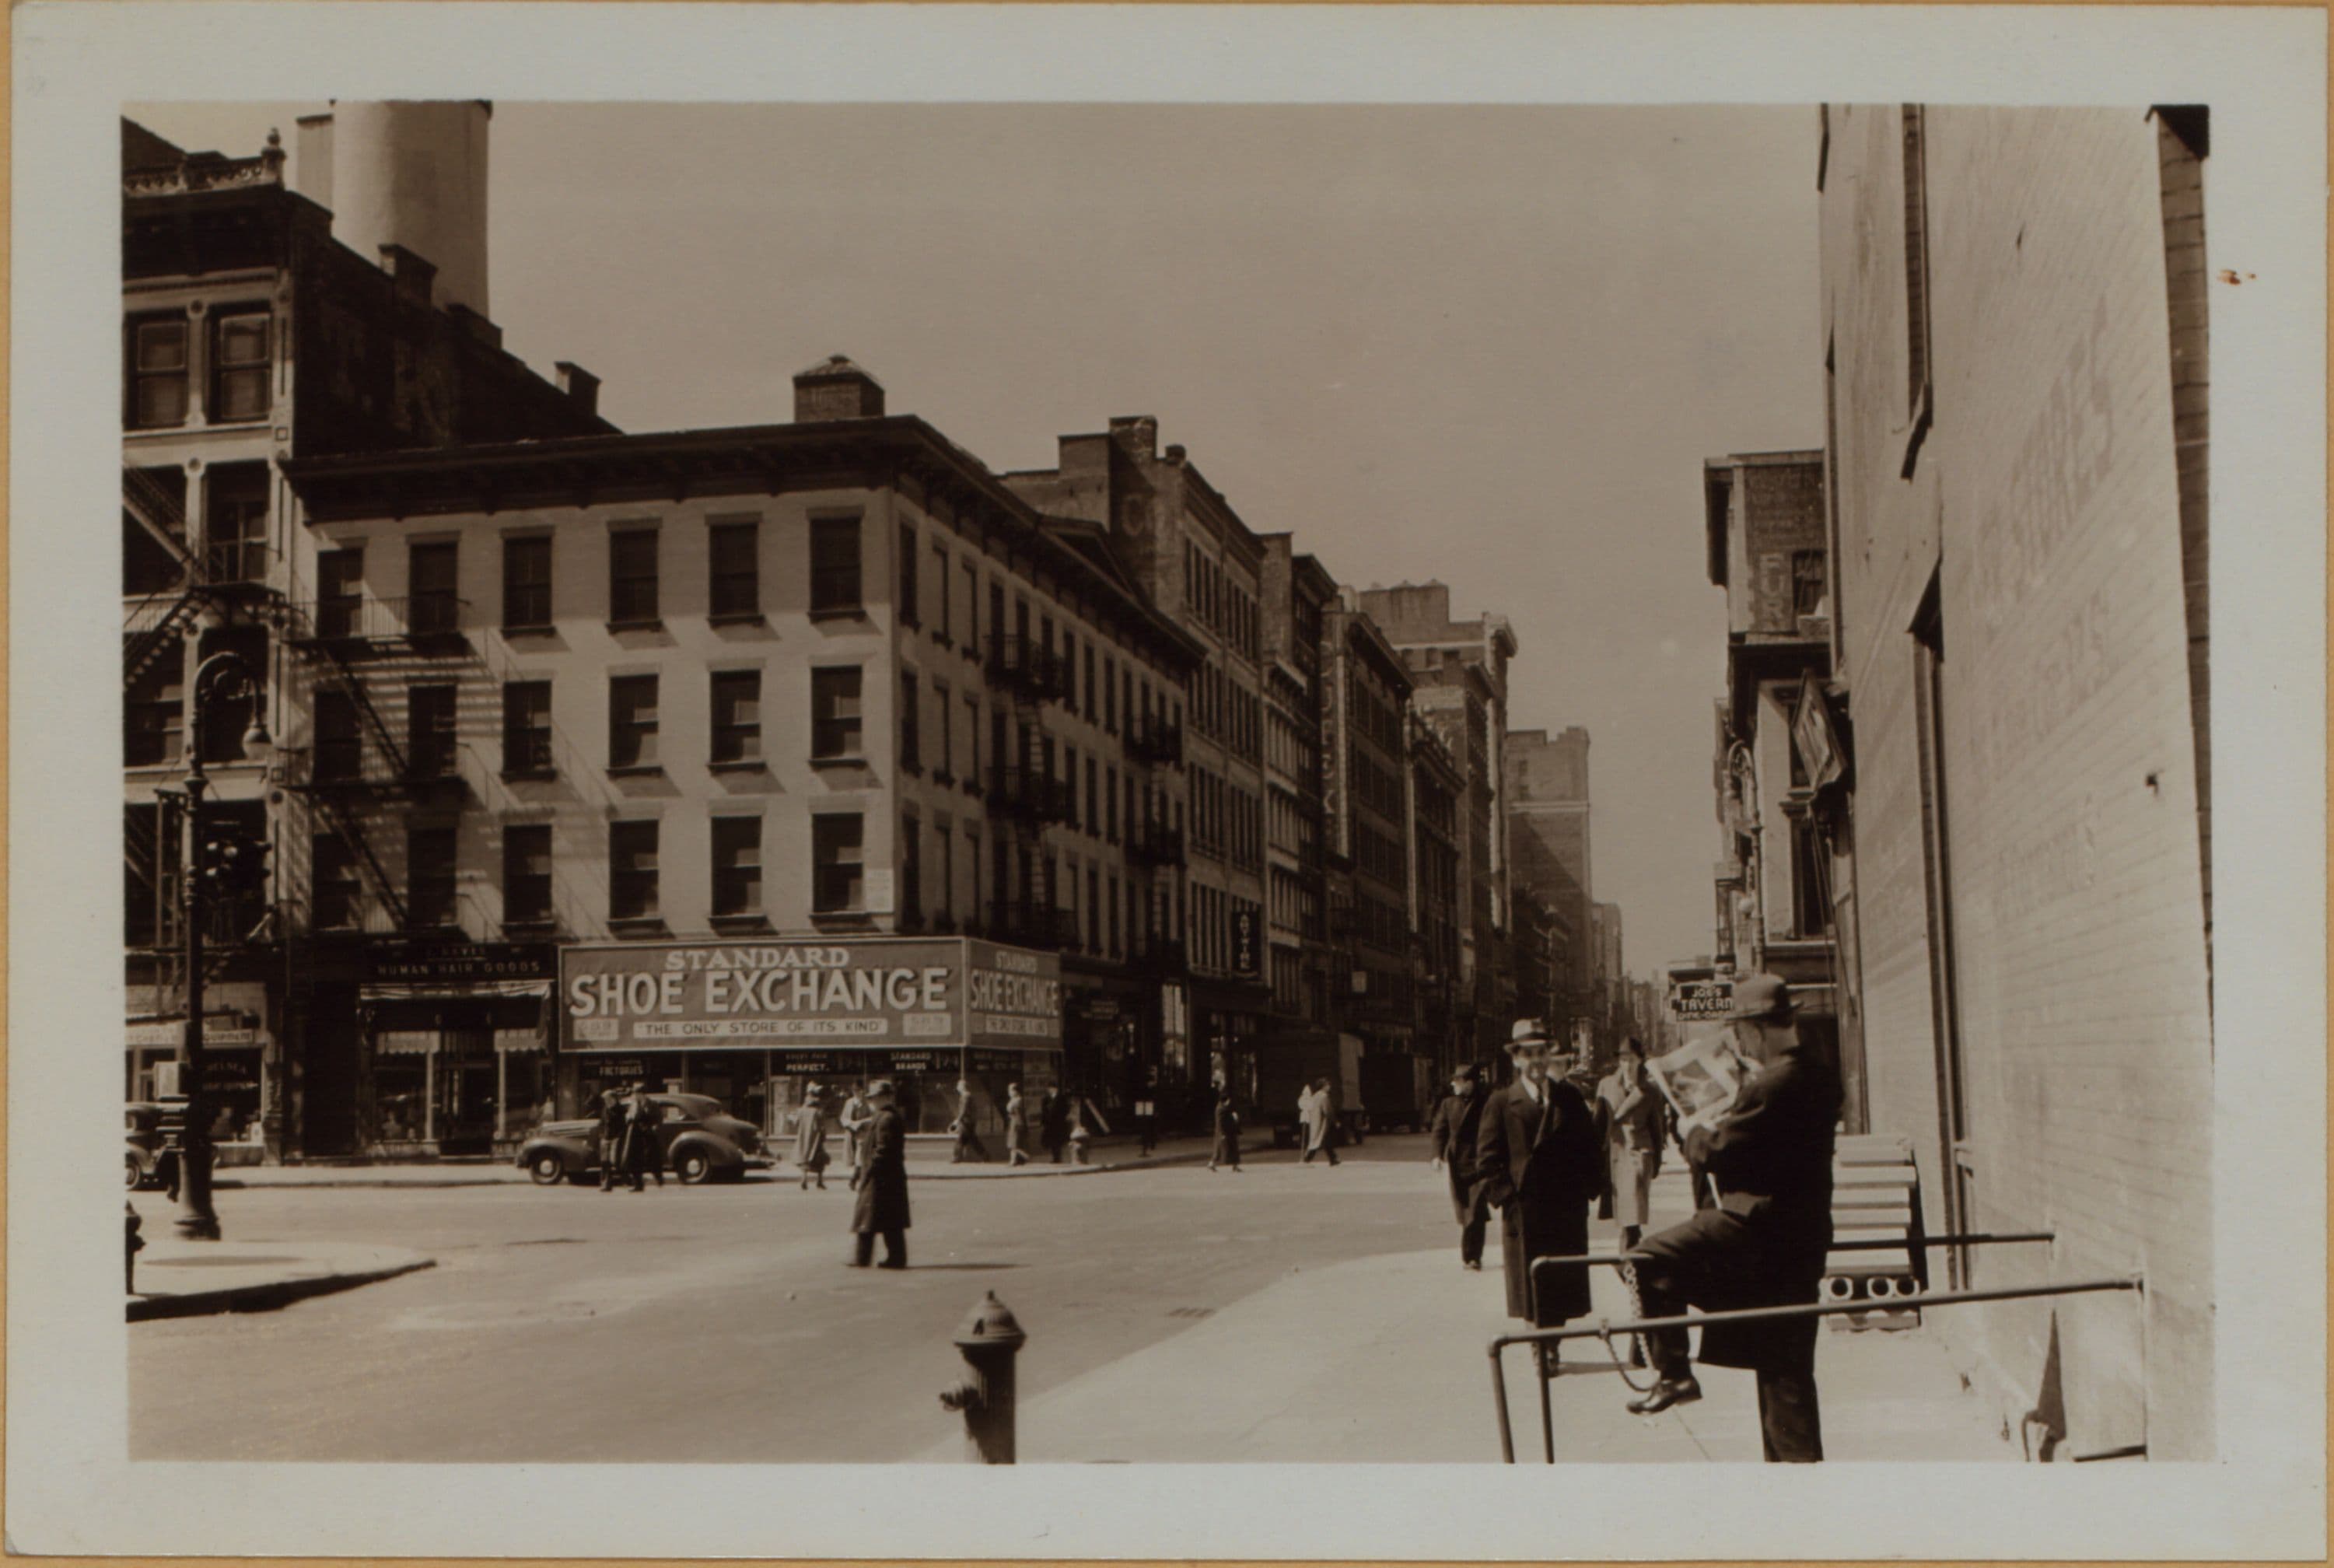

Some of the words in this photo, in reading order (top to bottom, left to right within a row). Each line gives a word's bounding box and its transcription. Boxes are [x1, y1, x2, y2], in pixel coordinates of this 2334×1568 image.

[666, 947, 850, 971] STANDARD
[378, 964, 429, 975] HUMAN
[439, 964, 474, 975] HAIR
[485, 961, 541, 972] GOODS
[570, 971, 684, 1017] SHOE
[706, 968, 948, 1013] EXCHANGE
[971, 969, 1003, 1011] SHOE
[1692, 985, 1722, 998] JOE'S
[1681, 997, 1733, 1011] TAVERN
[683, 1023, 720, 1035] ONLY
[730, 1021, 779, 1034] STORE
[787, 1020, 804, 1033] OF
[814, 1020, 836, 1033] ITS
